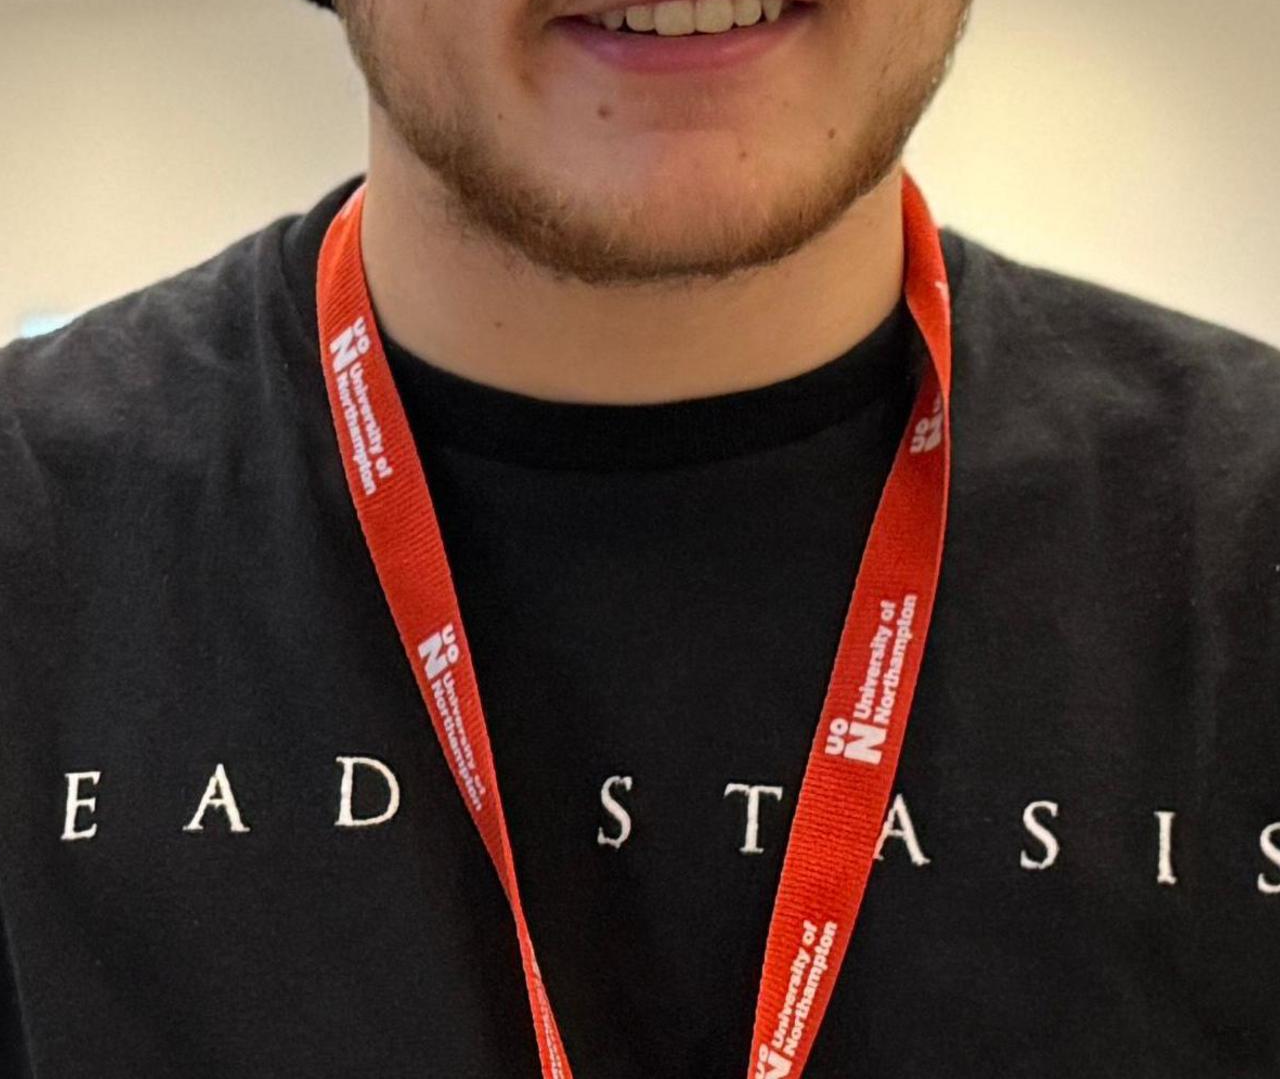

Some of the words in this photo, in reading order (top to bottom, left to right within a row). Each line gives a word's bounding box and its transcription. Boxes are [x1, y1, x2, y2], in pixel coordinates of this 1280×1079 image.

[329, 326, 360, 373] N
[336, 370, 377, 496] Northampton
[349, 361, 384, 455] University
[375, 456, 393, 479] of
[417, 631, 449, 680] N
[853, 624, 893, 720] University
[880, 599, 896, 622] of
[873, 594, 918, 725] Northampton
[431, 678, 483, 812] Northampton
[443, 670, 477, 770] University
[843, 720, 887, 765] N
[771, 947, 811, 1049] University
[802, 920, 818, 947] of
[782, 921, 838, 1057] Northampton
